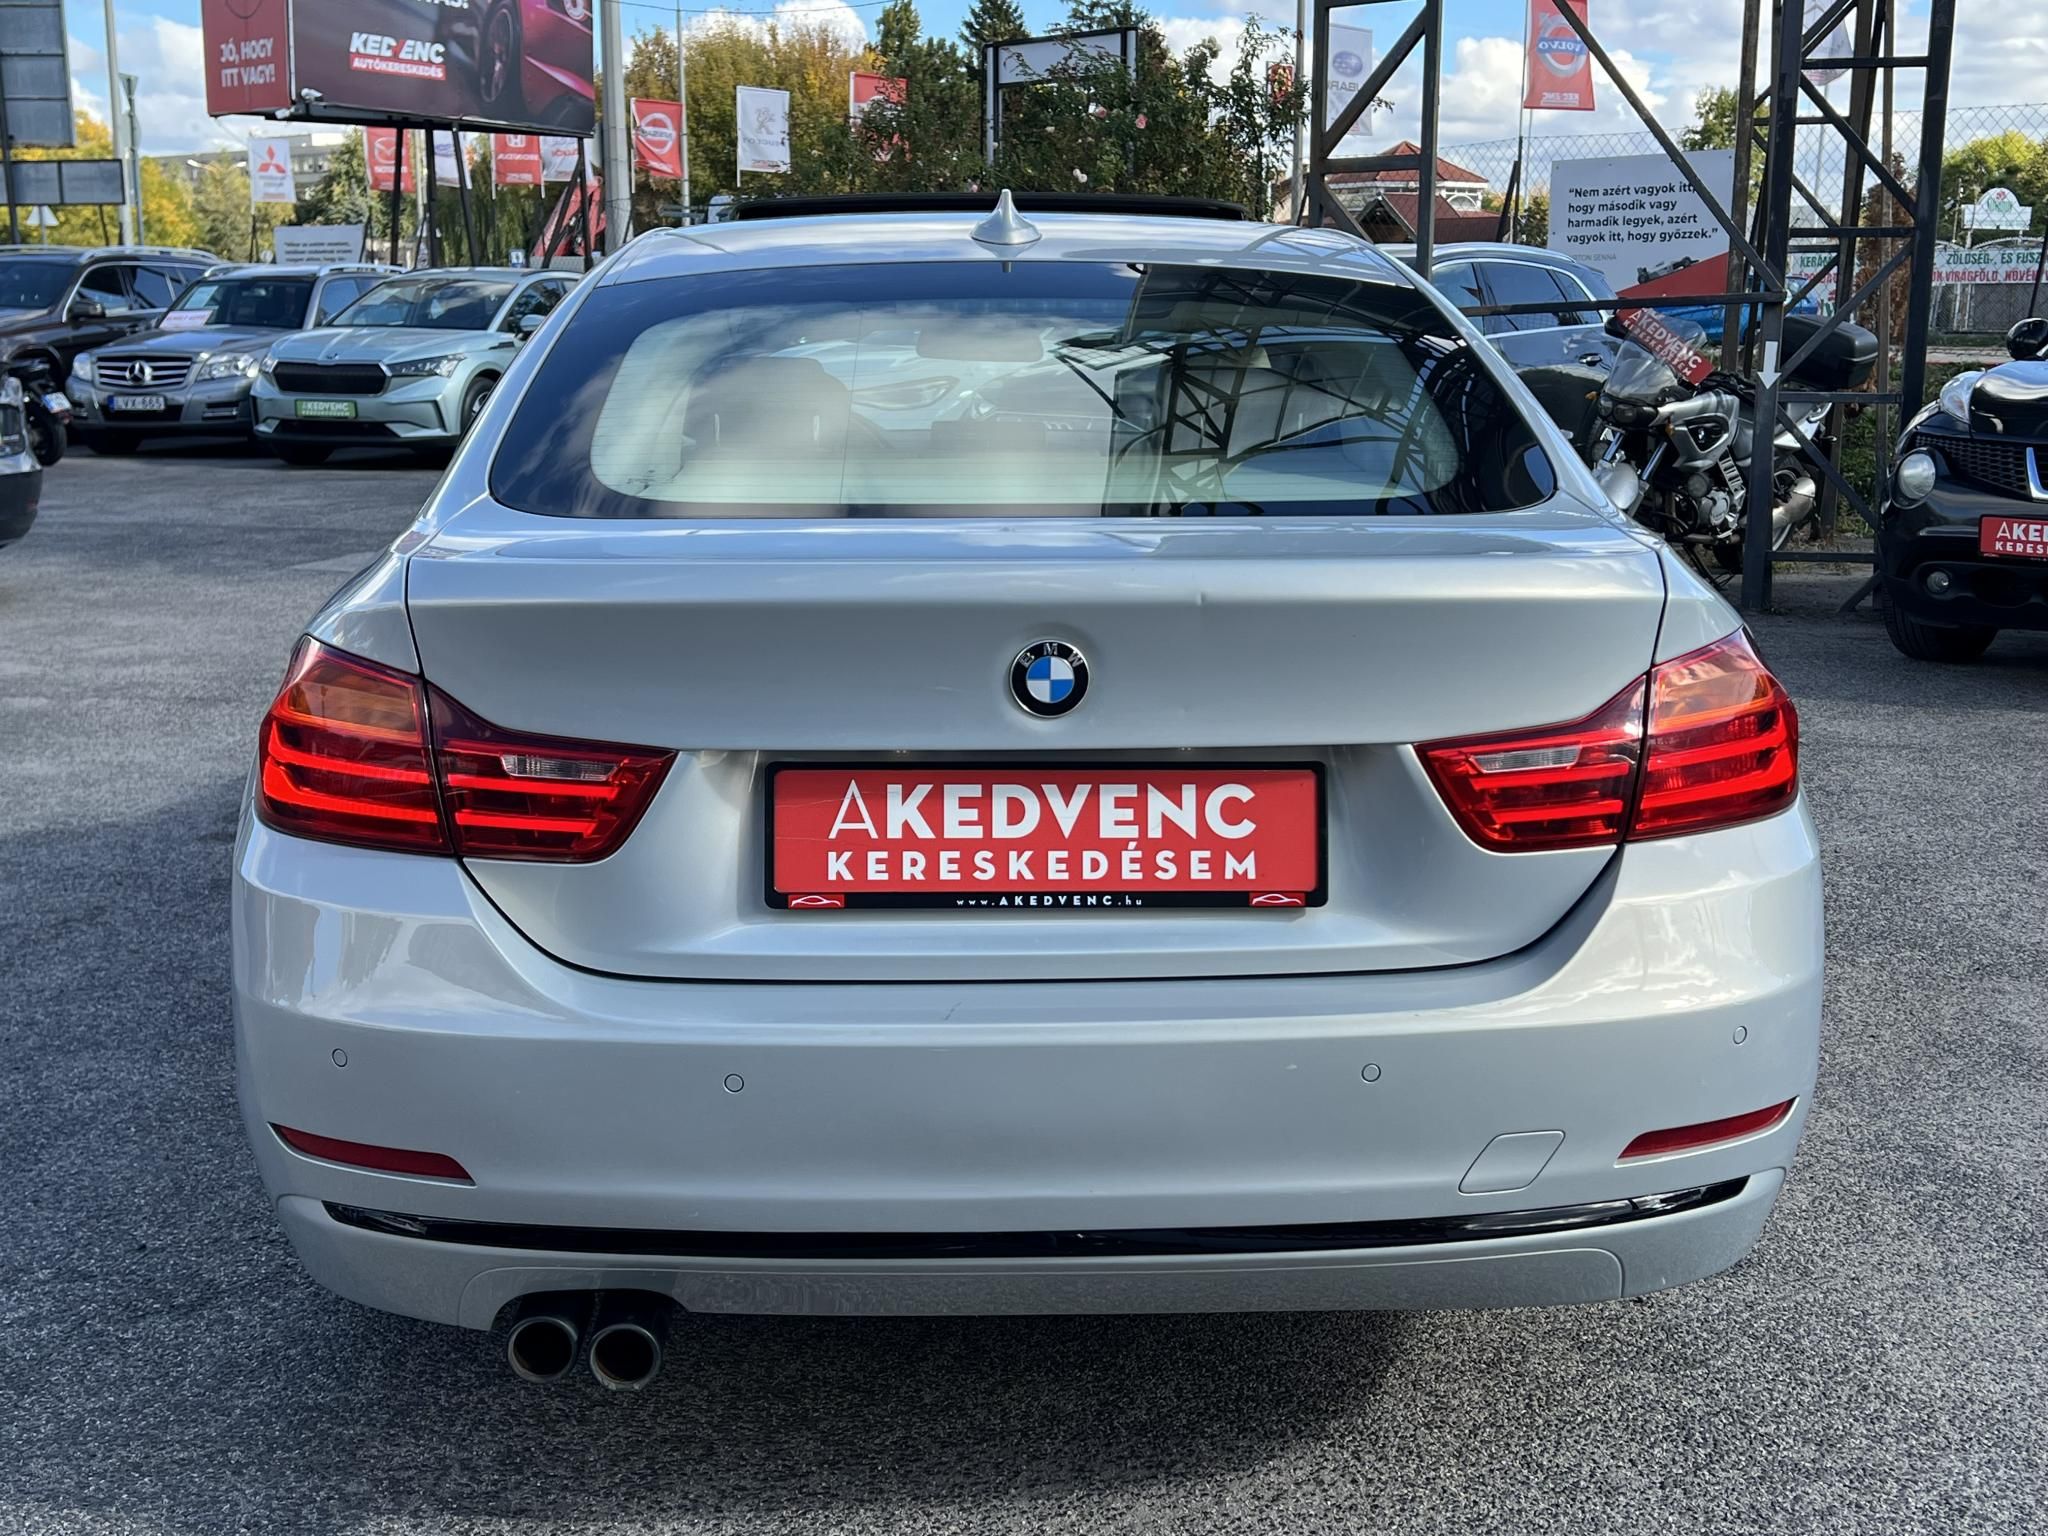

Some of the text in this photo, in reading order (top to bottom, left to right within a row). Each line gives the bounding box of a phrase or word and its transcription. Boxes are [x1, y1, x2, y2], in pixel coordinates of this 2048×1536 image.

[240, 37, 274, 60] HOGY
[221, 63, 275, 87] ITT VAGY!
[1602, 184, 1631, 196] azért
[1634, 182, 1675, 196] vagyok
[1568, 199, 1677, 214] hogy második vagy
[1568, 214, 1698, 228] harmadik legyek, azért
[1567, 230, 1605, 245] vagyok
[1608, 230, 1624, 243] itt,
[1628, 229, 1656, 243] hogy
[1995, 540, 2048, 554] KERES
[1018, 643, 1084, 669] BMW
[828, 779, 1257, 839] AKEDVENC
[827, 842, 1257, 881] KERESKEDÉSEM
[956, 895, 1142, 906] www.AKEDVENC.hu
